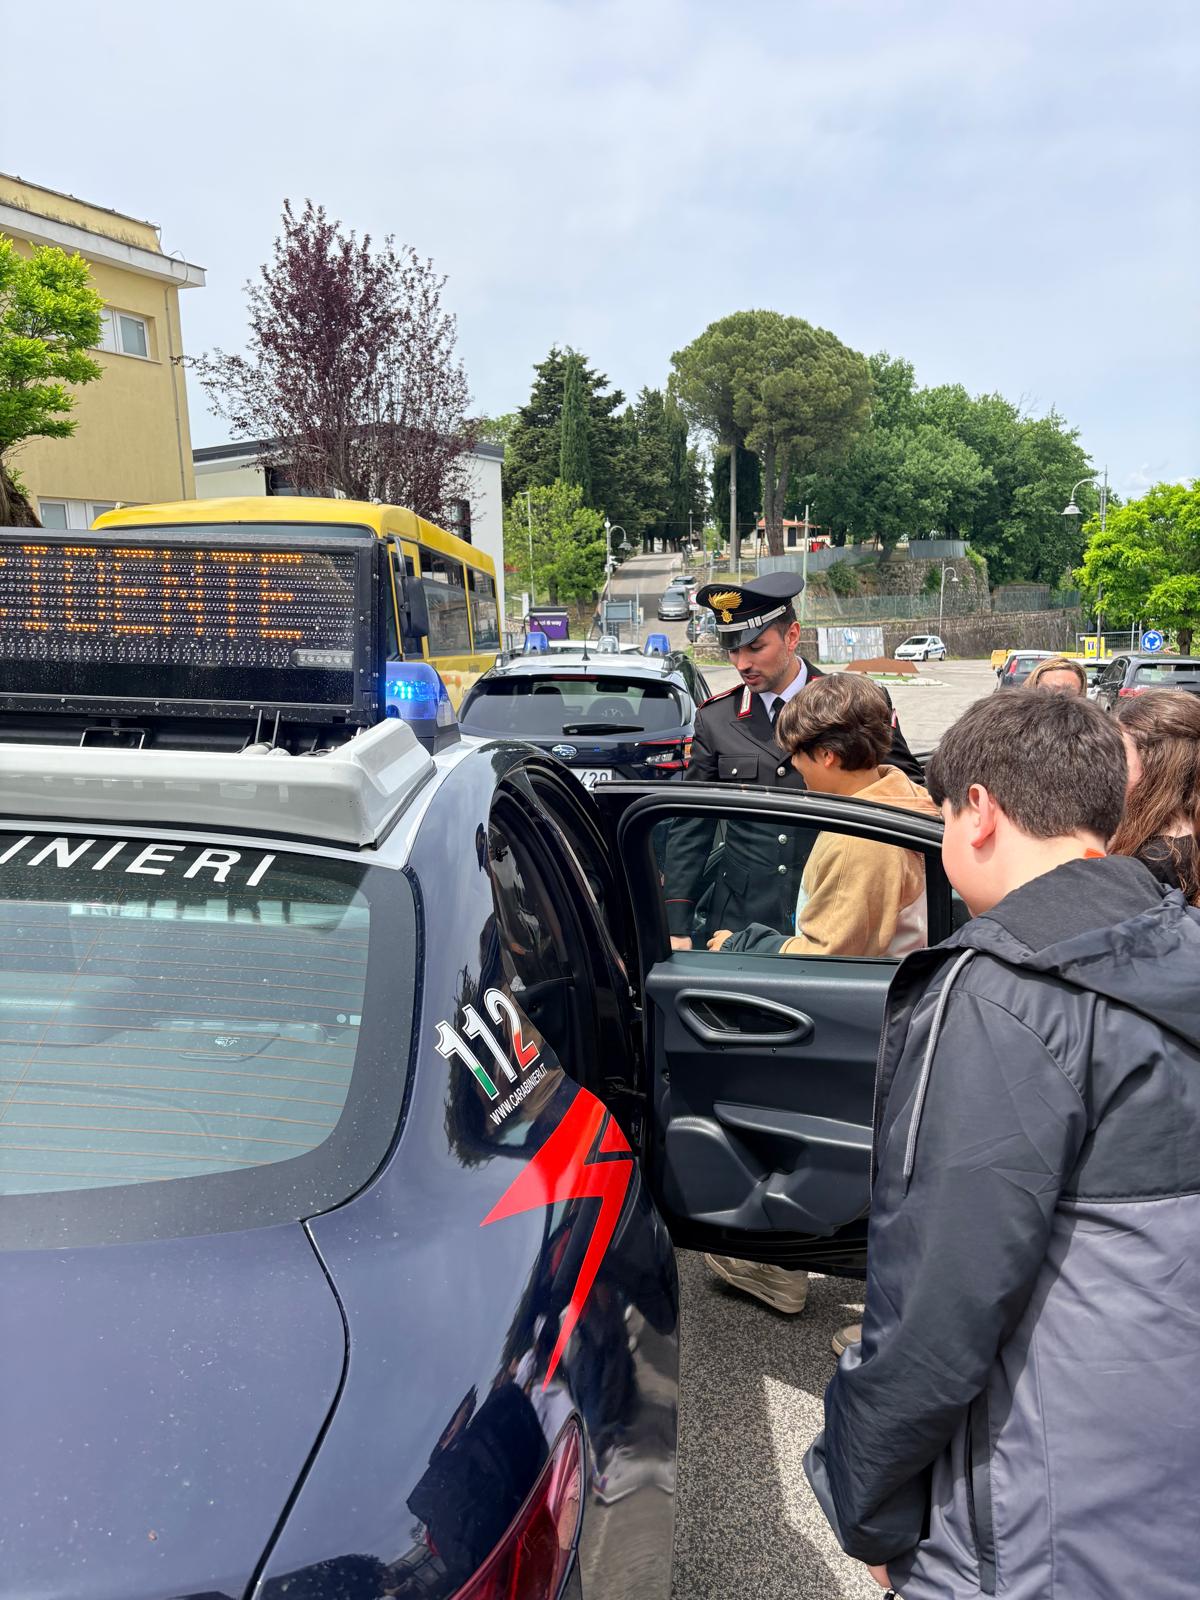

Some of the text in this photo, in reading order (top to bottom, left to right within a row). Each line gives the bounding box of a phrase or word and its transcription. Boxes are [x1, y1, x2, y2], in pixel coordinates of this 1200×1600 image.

[0, 545, 303, 639] IDENTE
[435, 987, 540, 1100] 112
[489, 1062, 548, 1126] WWW.CARABINIERI.IT
